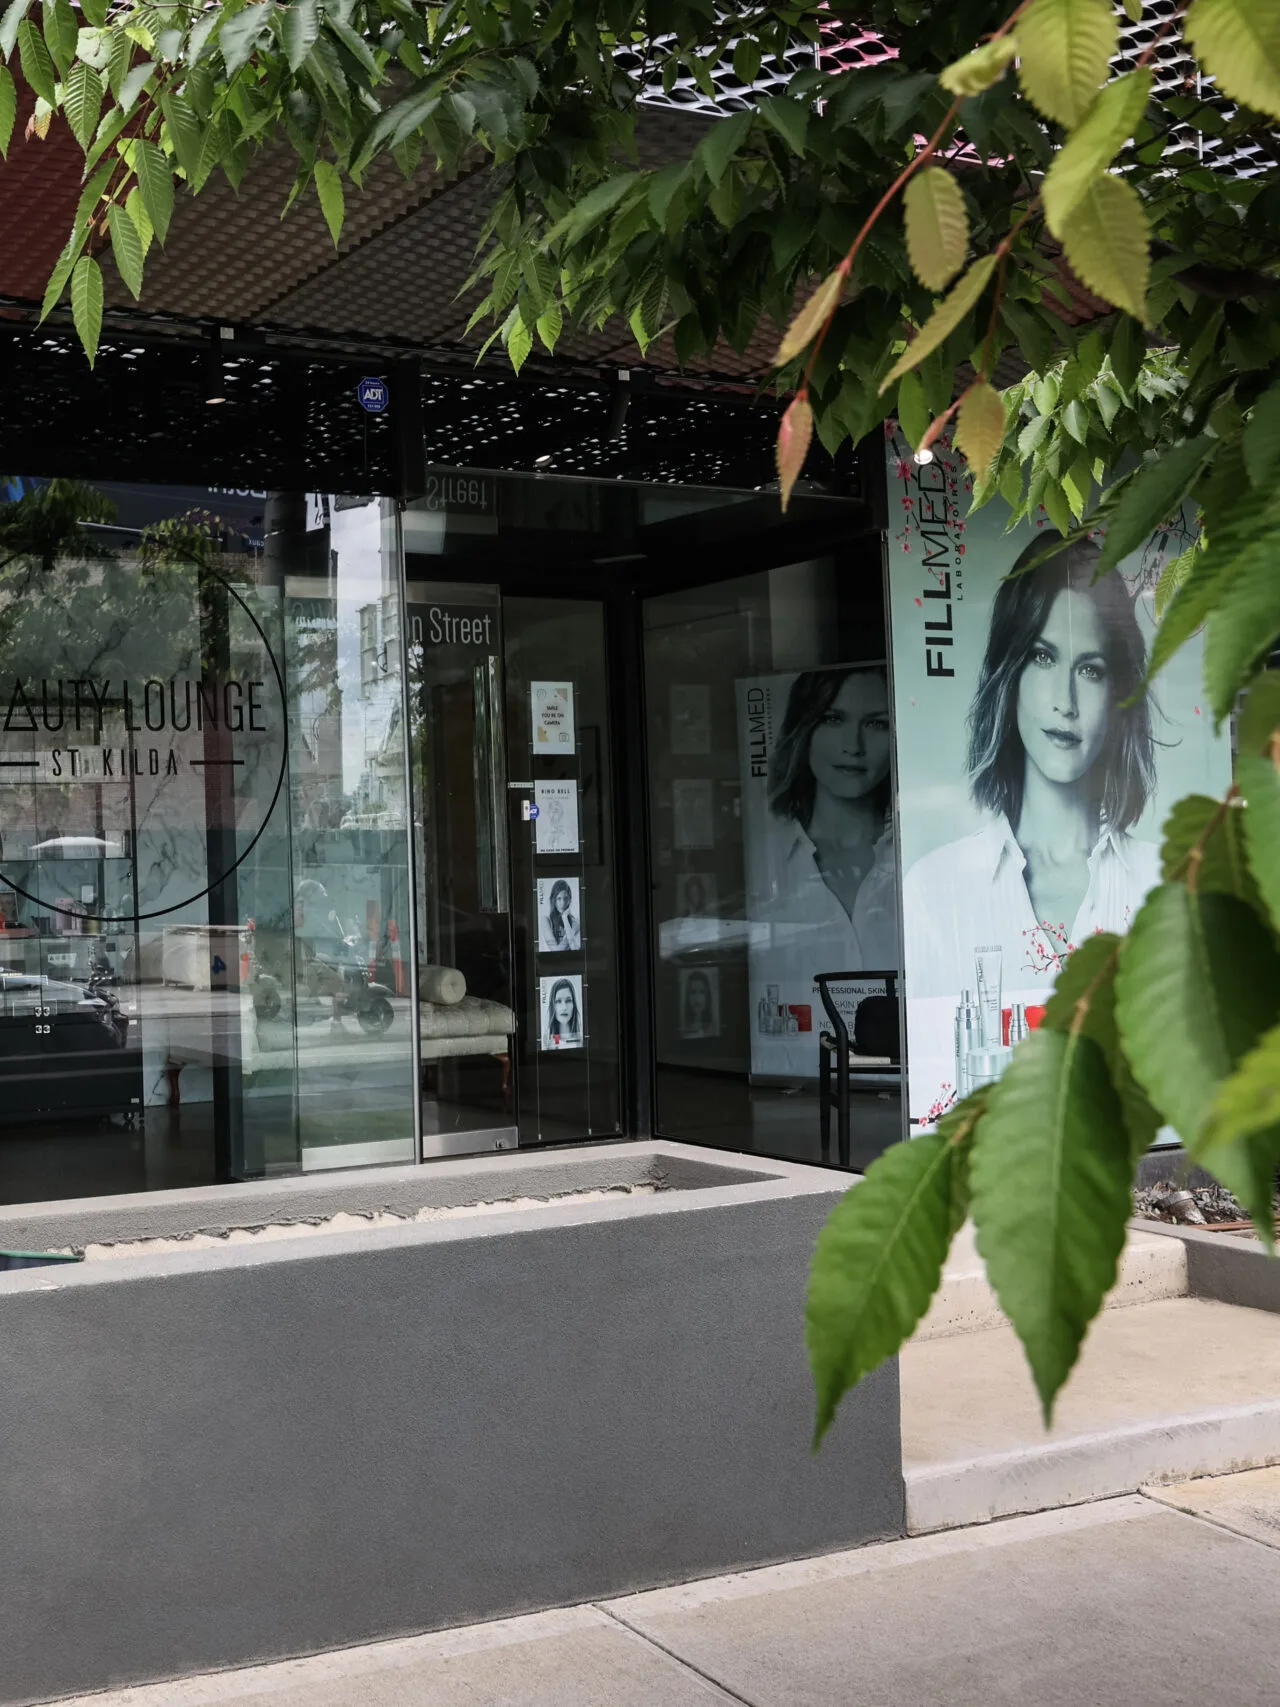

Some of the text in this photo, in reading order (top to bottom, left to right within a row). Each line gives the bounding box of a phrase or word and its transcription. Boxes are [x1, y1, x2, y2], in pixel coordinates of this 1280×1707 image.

[363, 388, 383, 401] ADT
[951, 466, 963, 601] LABORATOIRES
[918, 461, 955, 677] FILLMED
[429, 607, 491, 645] Street
[123, 680, 267, 732] LOUNGE
[747, 688, 768, 777] FILLMED
[103, 748, 178, 777] KILDA
